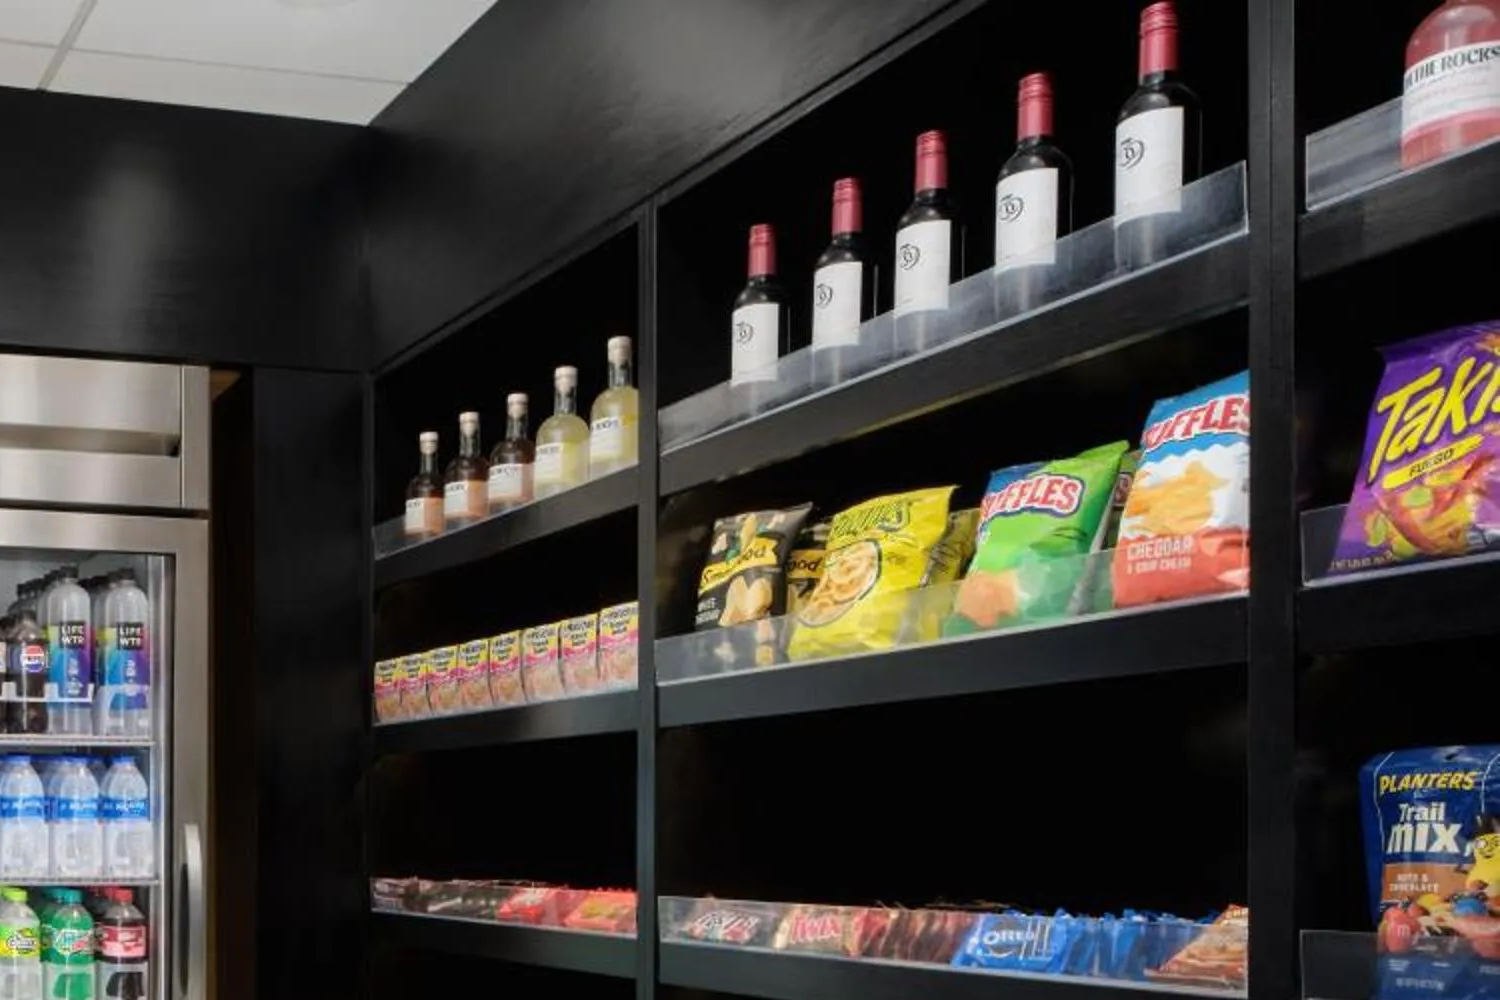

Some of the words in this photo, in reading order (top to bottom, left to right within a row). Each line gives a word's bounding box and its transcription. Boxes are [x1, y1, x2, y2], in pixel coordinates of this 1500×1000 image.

[1368, 356, 1500, 484] Taki
[61, 626, 84, 635] LIFE
[61, 635, 85, 645] WTR
[1379, 771, 1477, 796] PLANTERS
[1400, 801, 1445, 822] Trail
